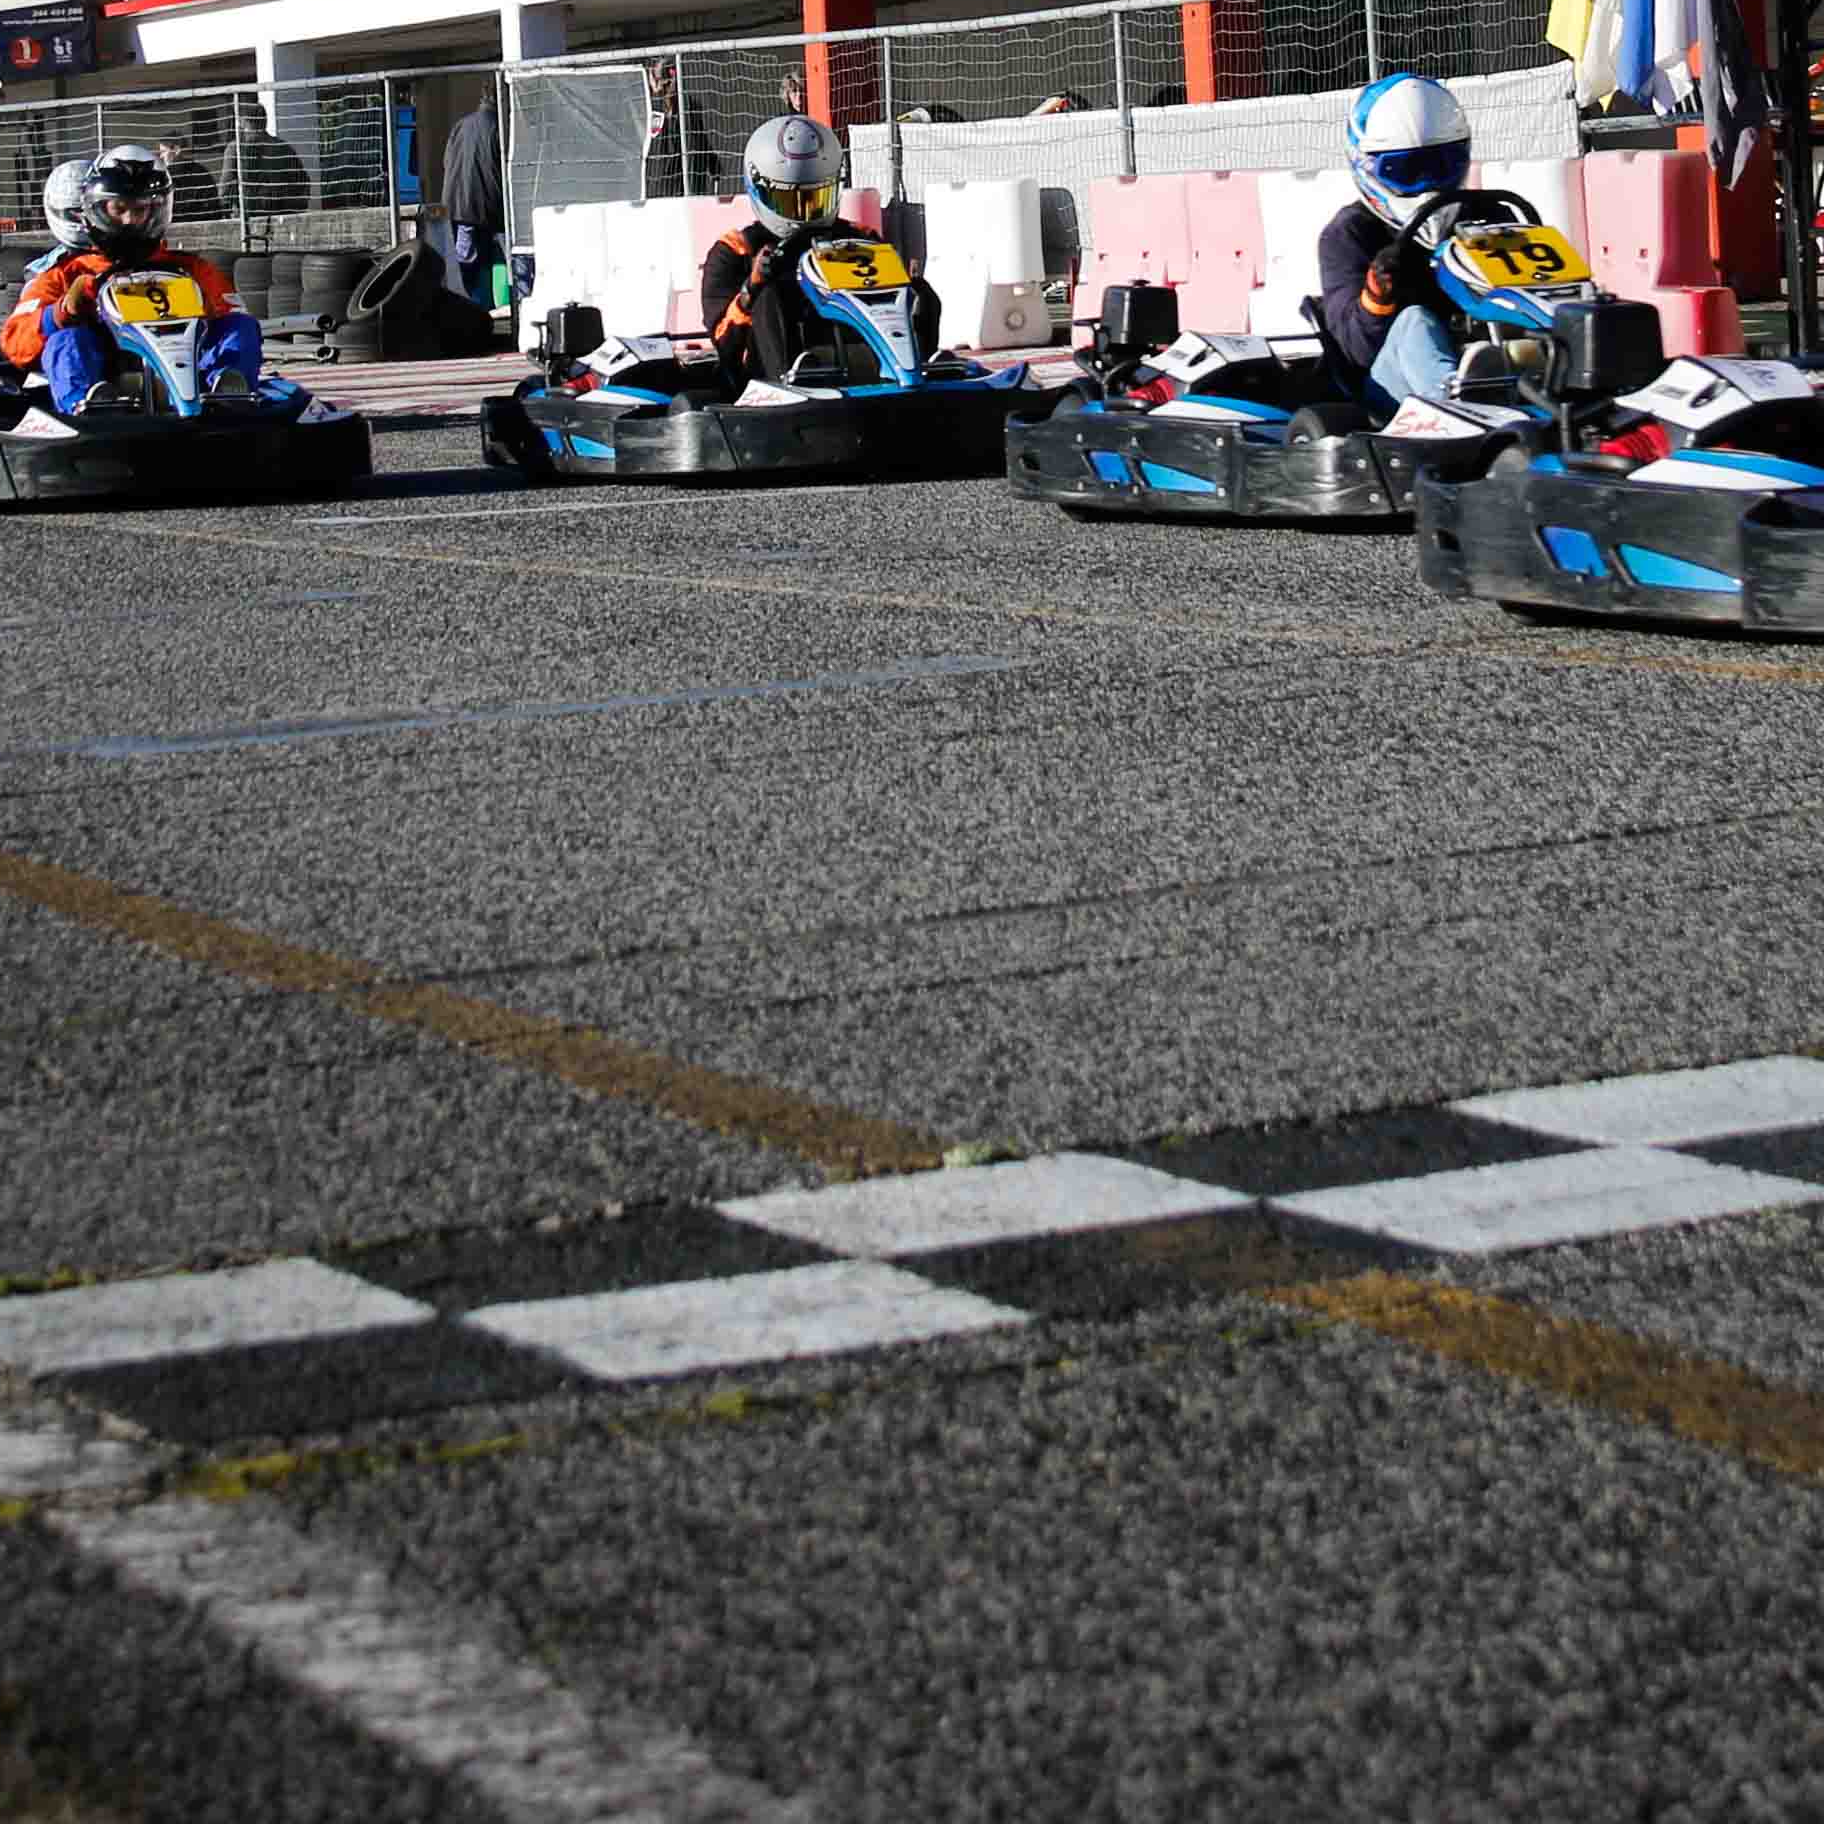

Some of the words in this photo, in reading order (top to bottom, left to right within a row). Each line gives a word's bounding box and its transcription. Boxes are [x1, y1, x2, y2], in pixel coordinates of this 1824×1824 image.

[850, 254, 879, 279] 3
[1484, 242, 1565, 277] 19
[145, 287, 170, 318] 9
